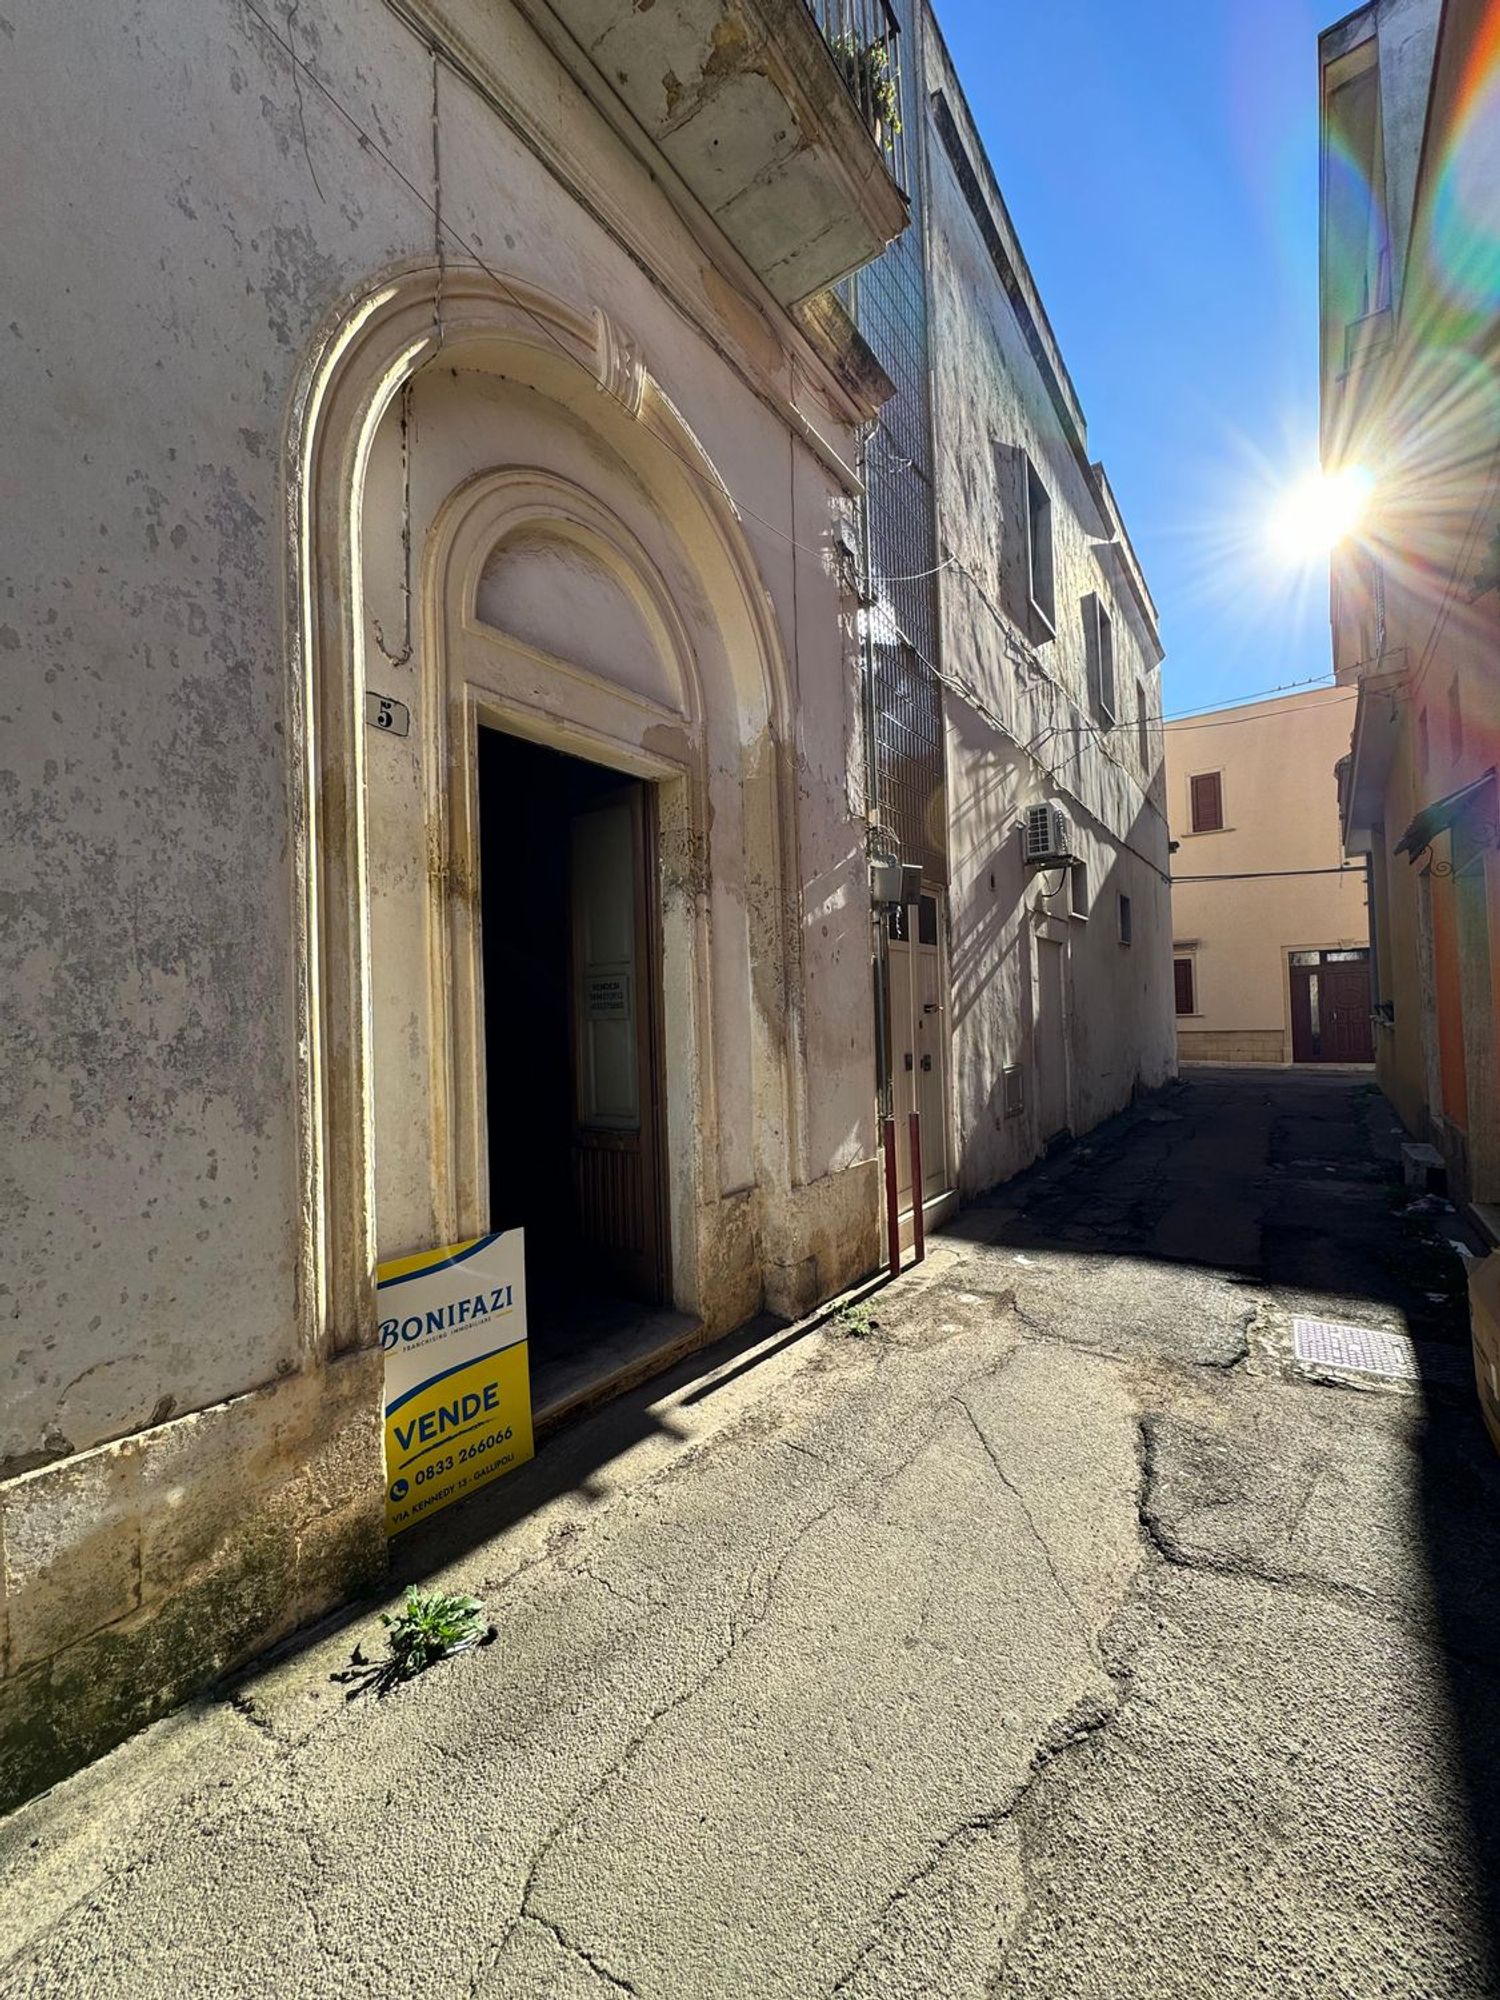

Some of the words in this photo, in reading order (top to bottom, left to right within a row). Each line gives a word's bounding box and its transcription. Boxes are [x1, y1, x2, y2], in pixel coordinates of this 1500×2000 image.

[377, 700, 393, 728] 5
[378, 1284, 513, 1351] BONIFAZI
[393, 1382, 500, 1451] VENDE
[391, 1510, 410, 1524] VIA
[411, 1483, 455, 1513] KENNEDY
[473, 1453, 515, 1480] GALLIPOLI
[415, 1456, 454, 1485] 0833
[458, 1426, 513, 1464] 266066
